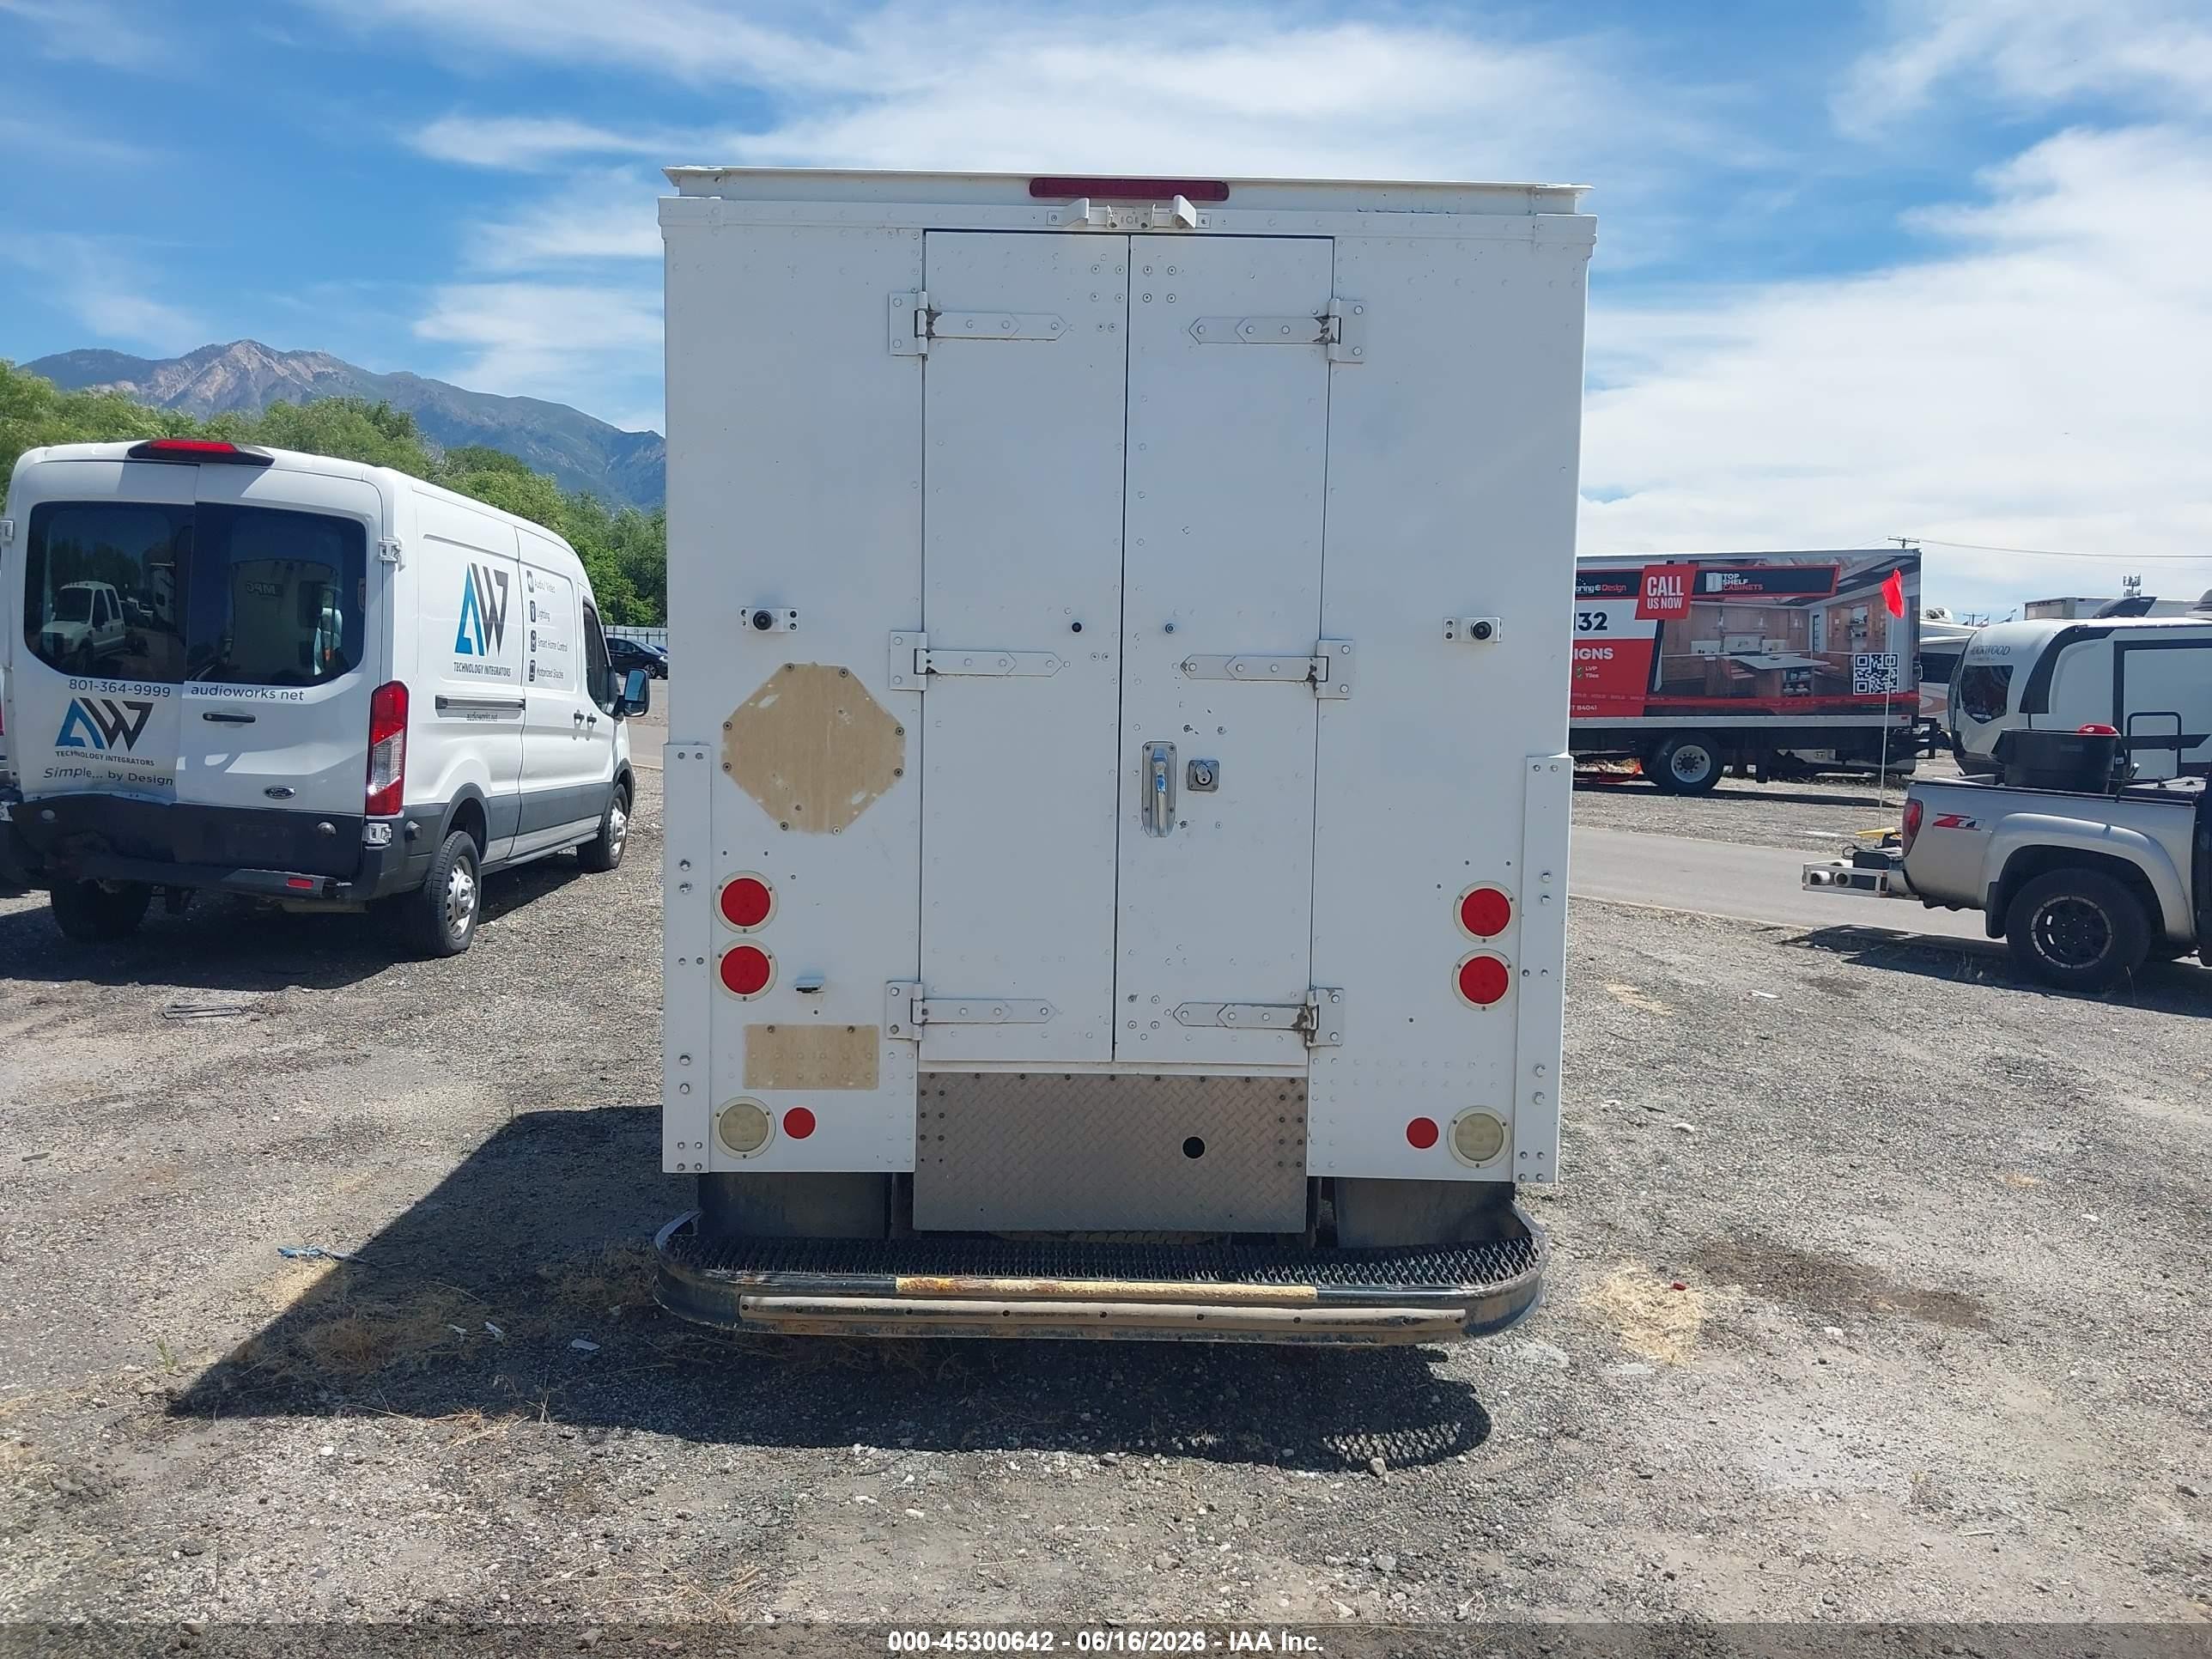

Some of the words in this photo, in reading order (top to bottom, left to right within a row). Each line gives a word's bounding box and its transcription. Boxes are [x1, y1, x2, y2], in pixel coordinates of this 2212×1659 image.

[1647, 575, 1685, 597] CALL
[1647, 597, 1660, 610] US
[1661, 597, 1683, 610] NOW
[453, 662, 483, 674] TECHNOLOGY
[484, 665, 512, 677] INTEGRATORS
[69, 678, 171, 697] 801-364-9999
[55, 750, 104, 761] TECHNOLOGY
[105, 755, 155, 767] INTEGRATORS
[108, 770, 123, 781] by
[128, 772, 173, 787] Design
